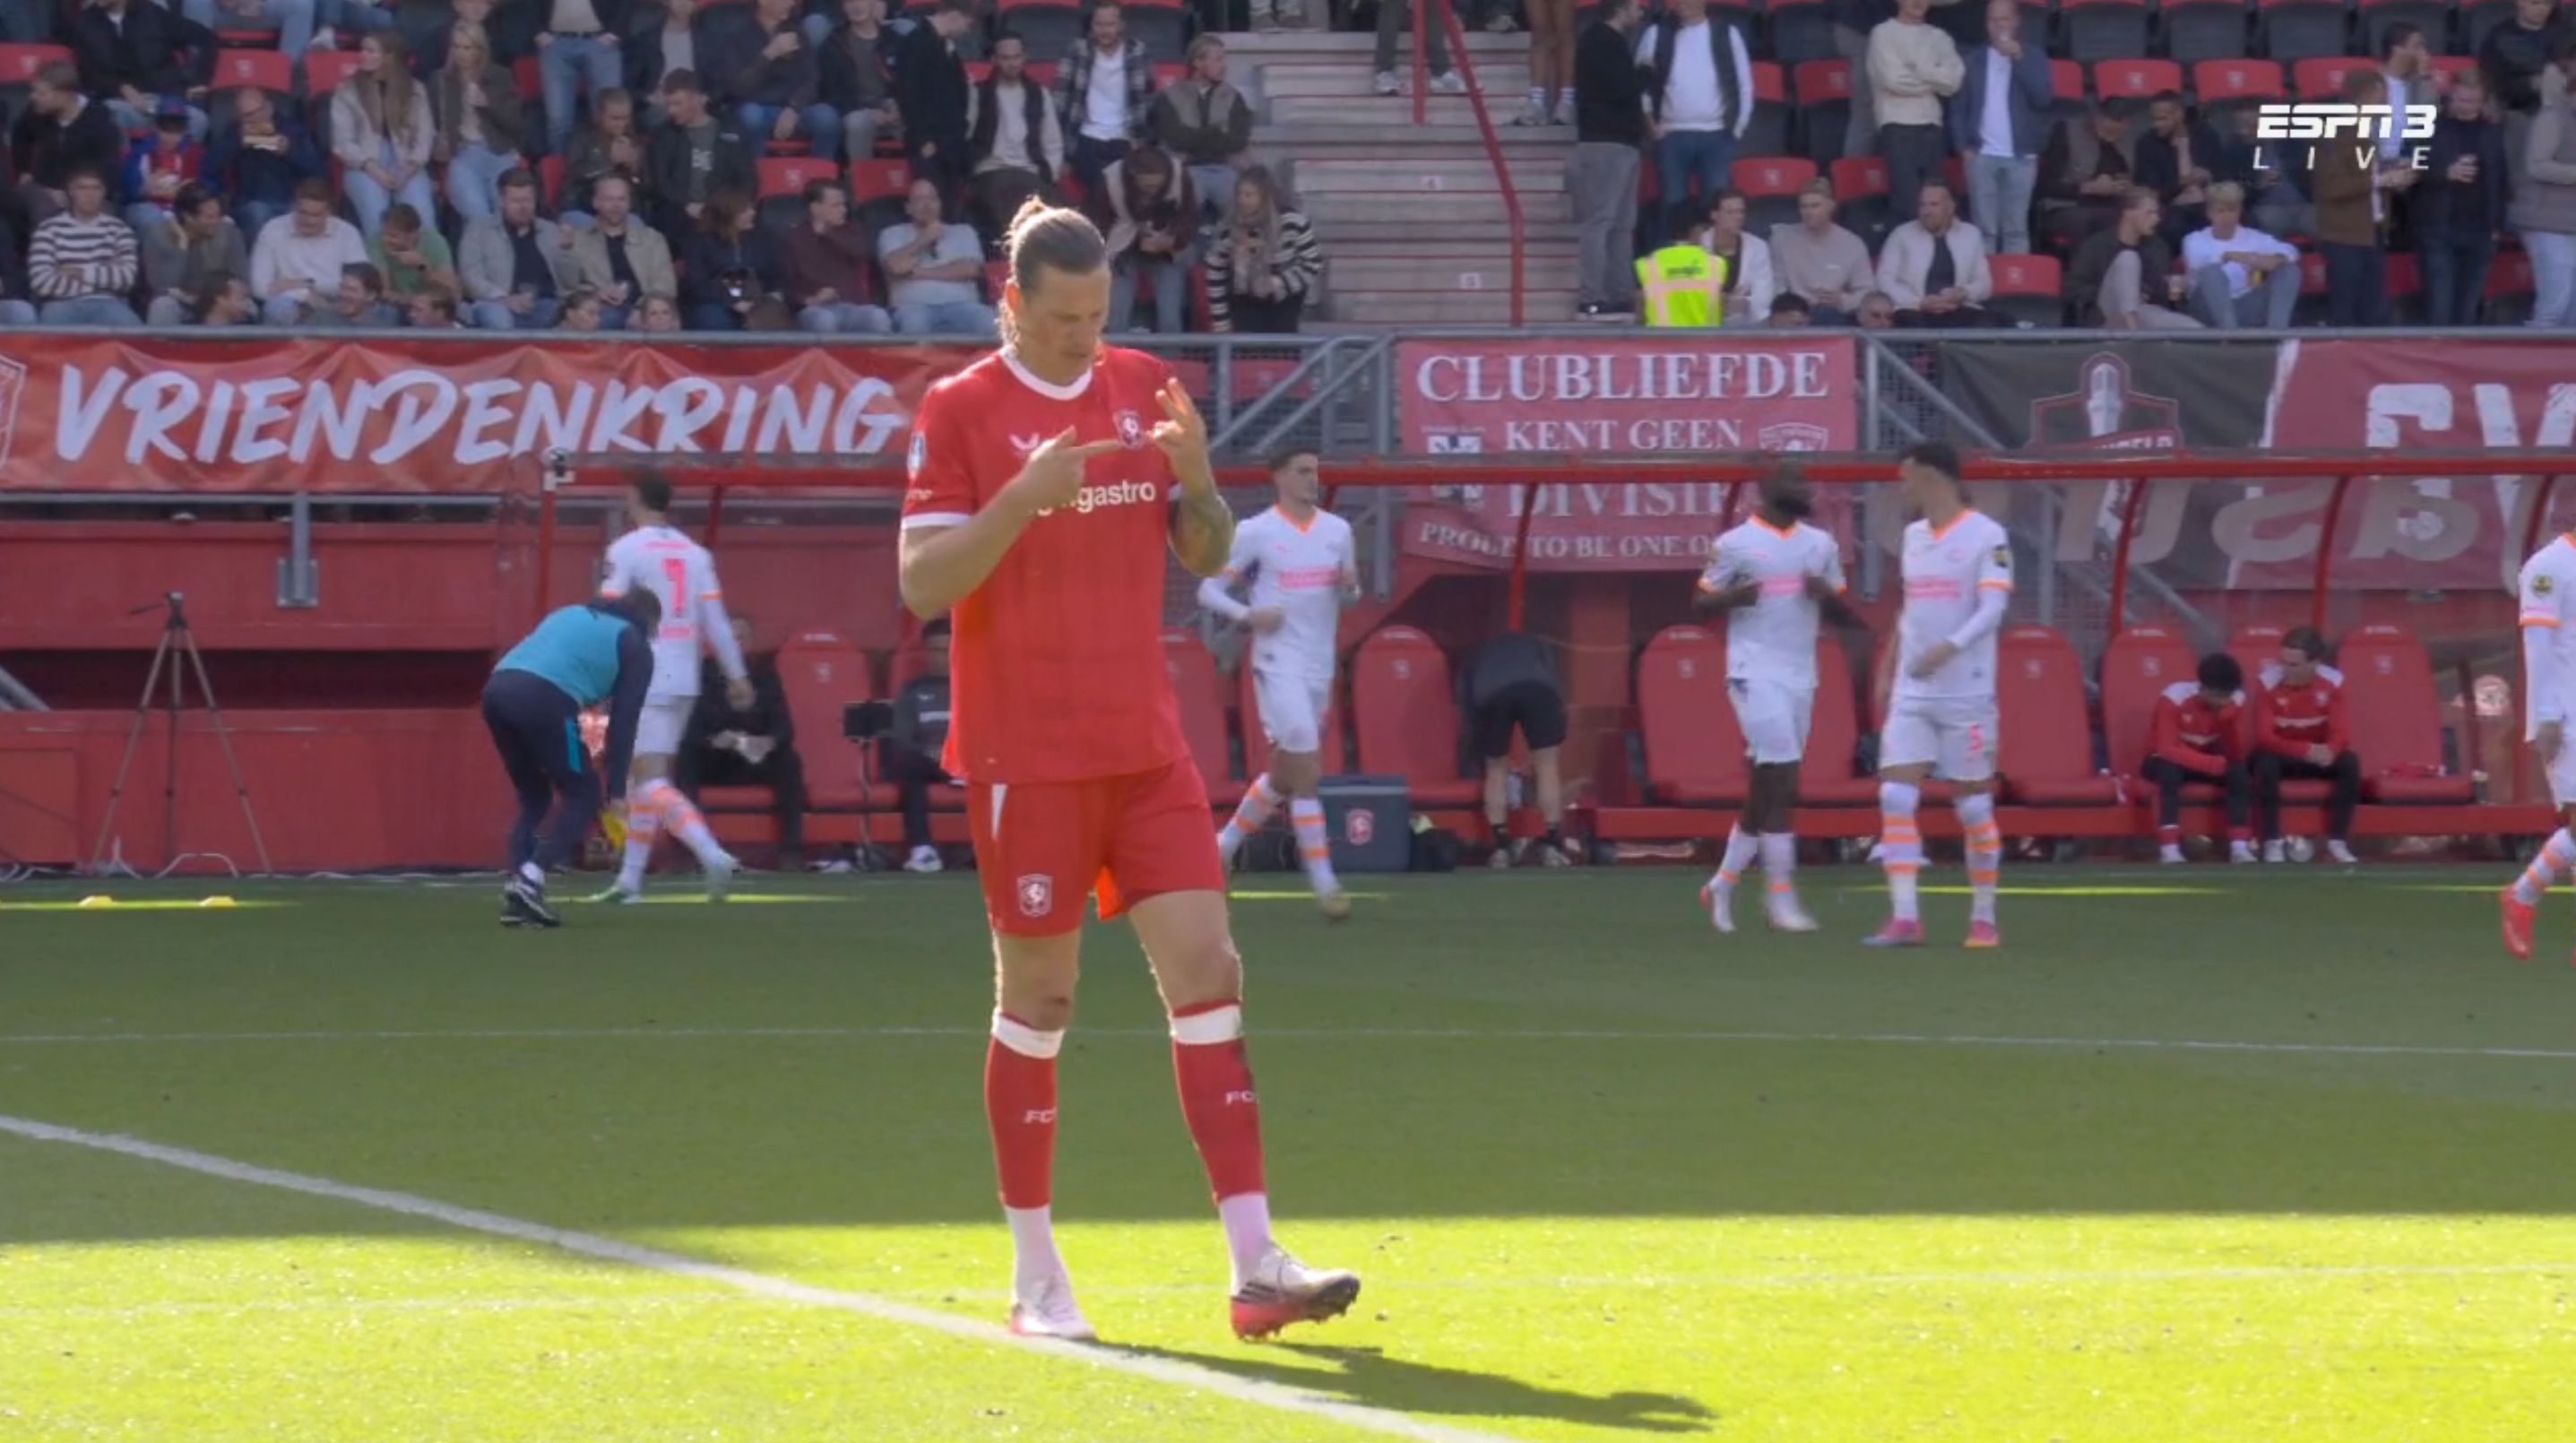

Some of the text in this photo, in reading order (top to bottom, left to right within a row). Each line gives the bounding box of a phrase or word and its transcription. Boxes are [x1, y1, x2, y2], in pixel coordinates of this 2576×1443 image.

[1416, 351, 1829, 402] CLUBLIEFDE
[56, 362, 909, 464] VRIENDENKRING
[1505, 419, 1618, 451] KENT
[1628, 418, 1742, 451] GEEN
[1529, 536, 1569, 557] TO
[1577, 536, 1613, 557] BE
[1620, 536, 1683, 557] ONE
